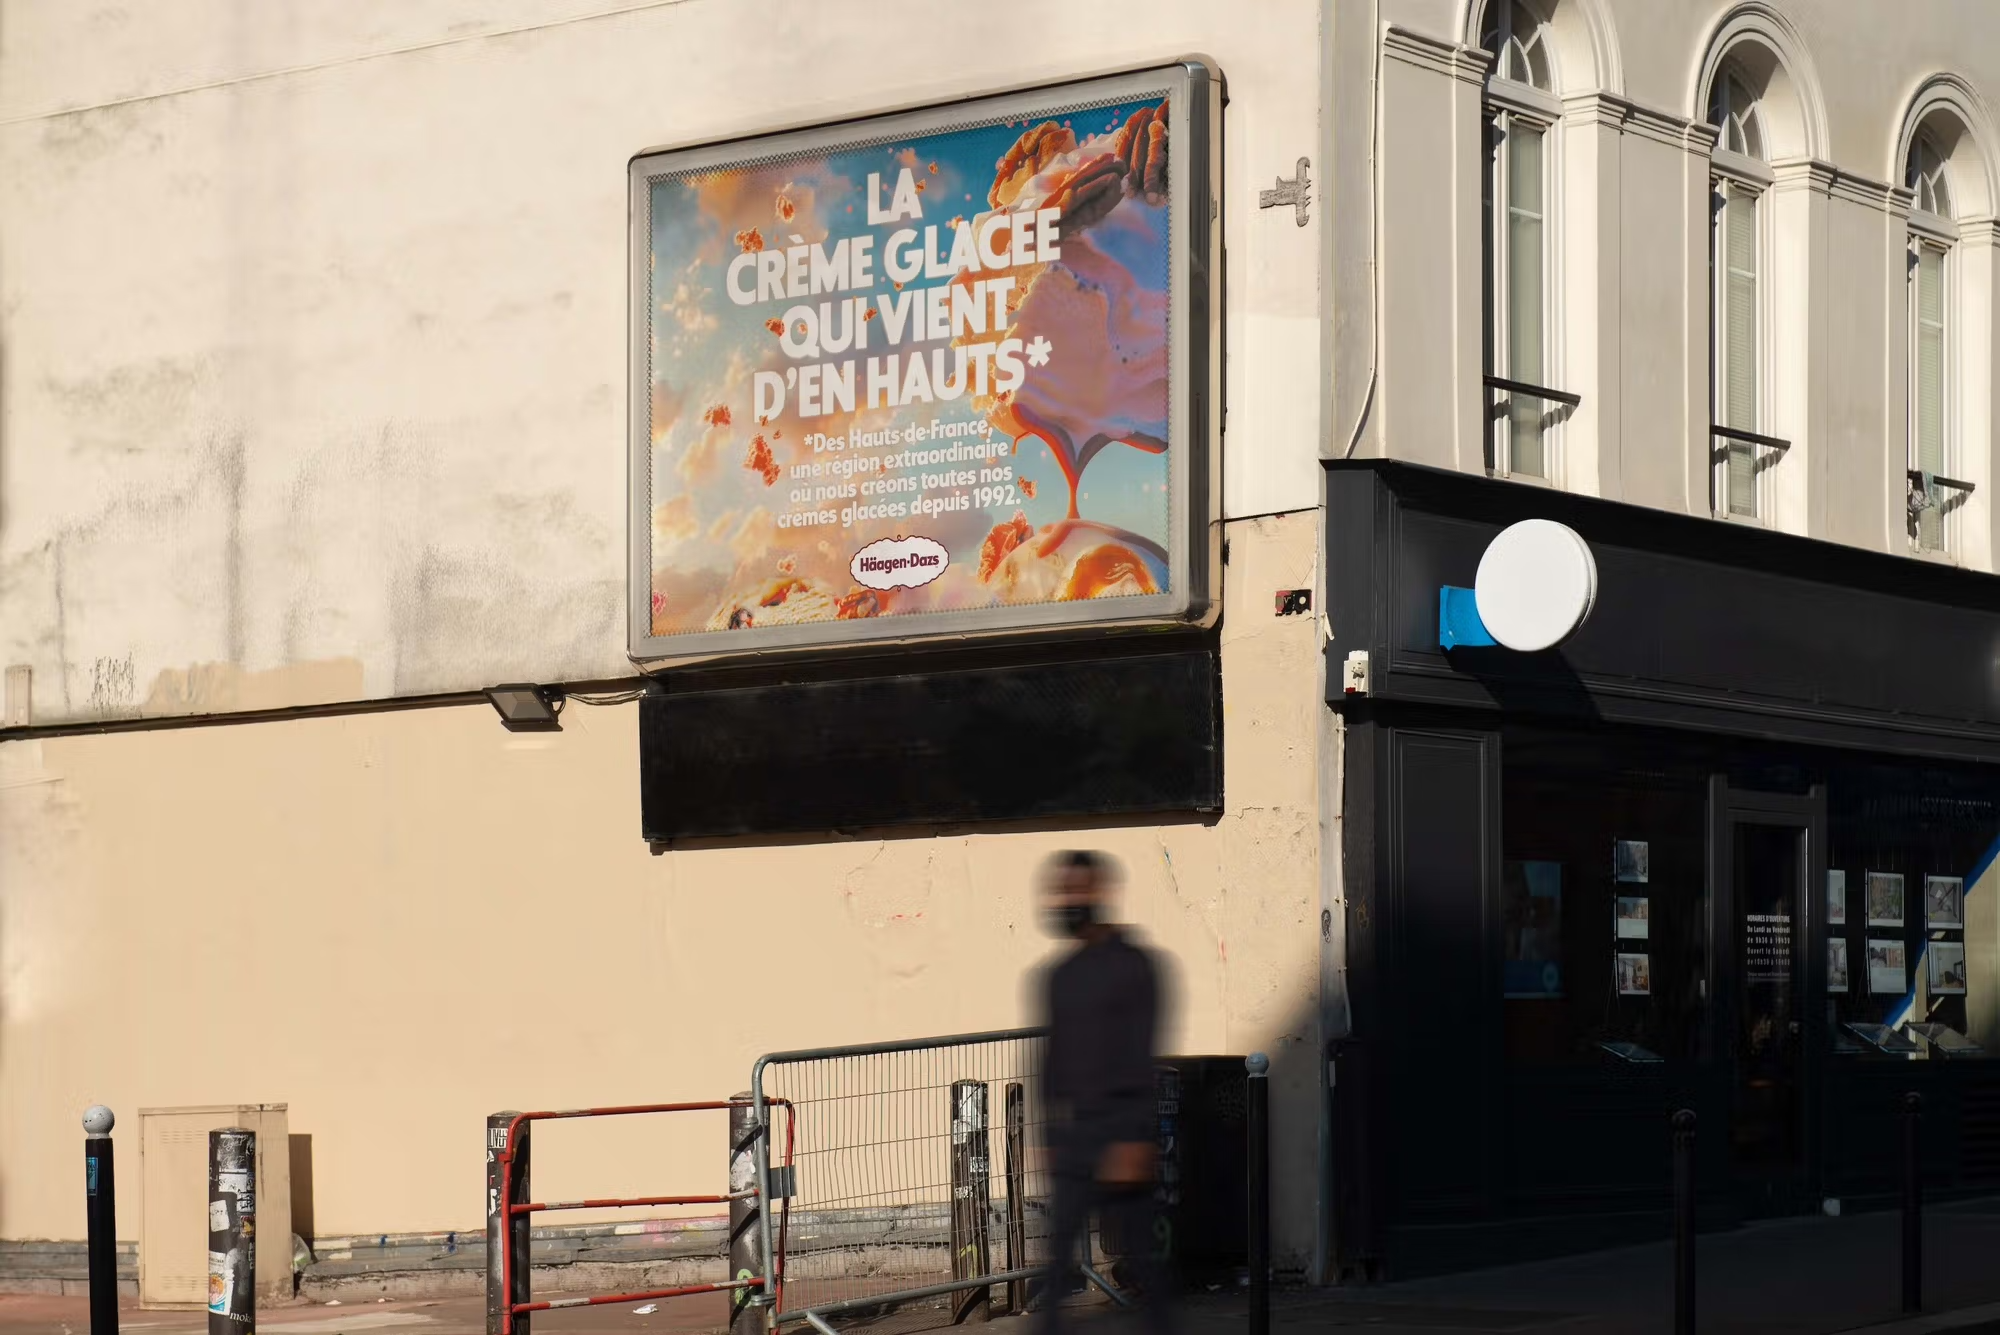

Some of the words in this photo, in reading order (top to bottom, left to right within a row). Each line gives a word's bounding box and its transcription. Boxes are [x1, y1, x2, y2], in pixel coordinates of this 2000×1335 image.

[867, 168, 923, 226] LA
[726, 234, 874, 305] CRÈME
[883, 198, 1061, 283] GLACÉE
[779, 297, 868, 358] QUI
[876, 276, 1016, 345] VIENT
[790, 463, 821, 480] une
[825, 455, 880, 481] région
[884, 438, 1008, 470] extraordinaire
[790, 482, 812, 503] où
[815, 482, 857, 501] nous
[860, 474, 917, 496] créons
[921, 469, 976, 490] toutes
[980, 466, 1013, 484] nos
[841, 498, 907, 527] glacées
[911, 491, 970, 519] depuis
[972, 484, 1021, 508] 1992.
[1747, 947, 1764, 955] Ouvert
[1753, 925, 1766, 933] Lundi
[1772, 926, 1790, 934] Vendredi
